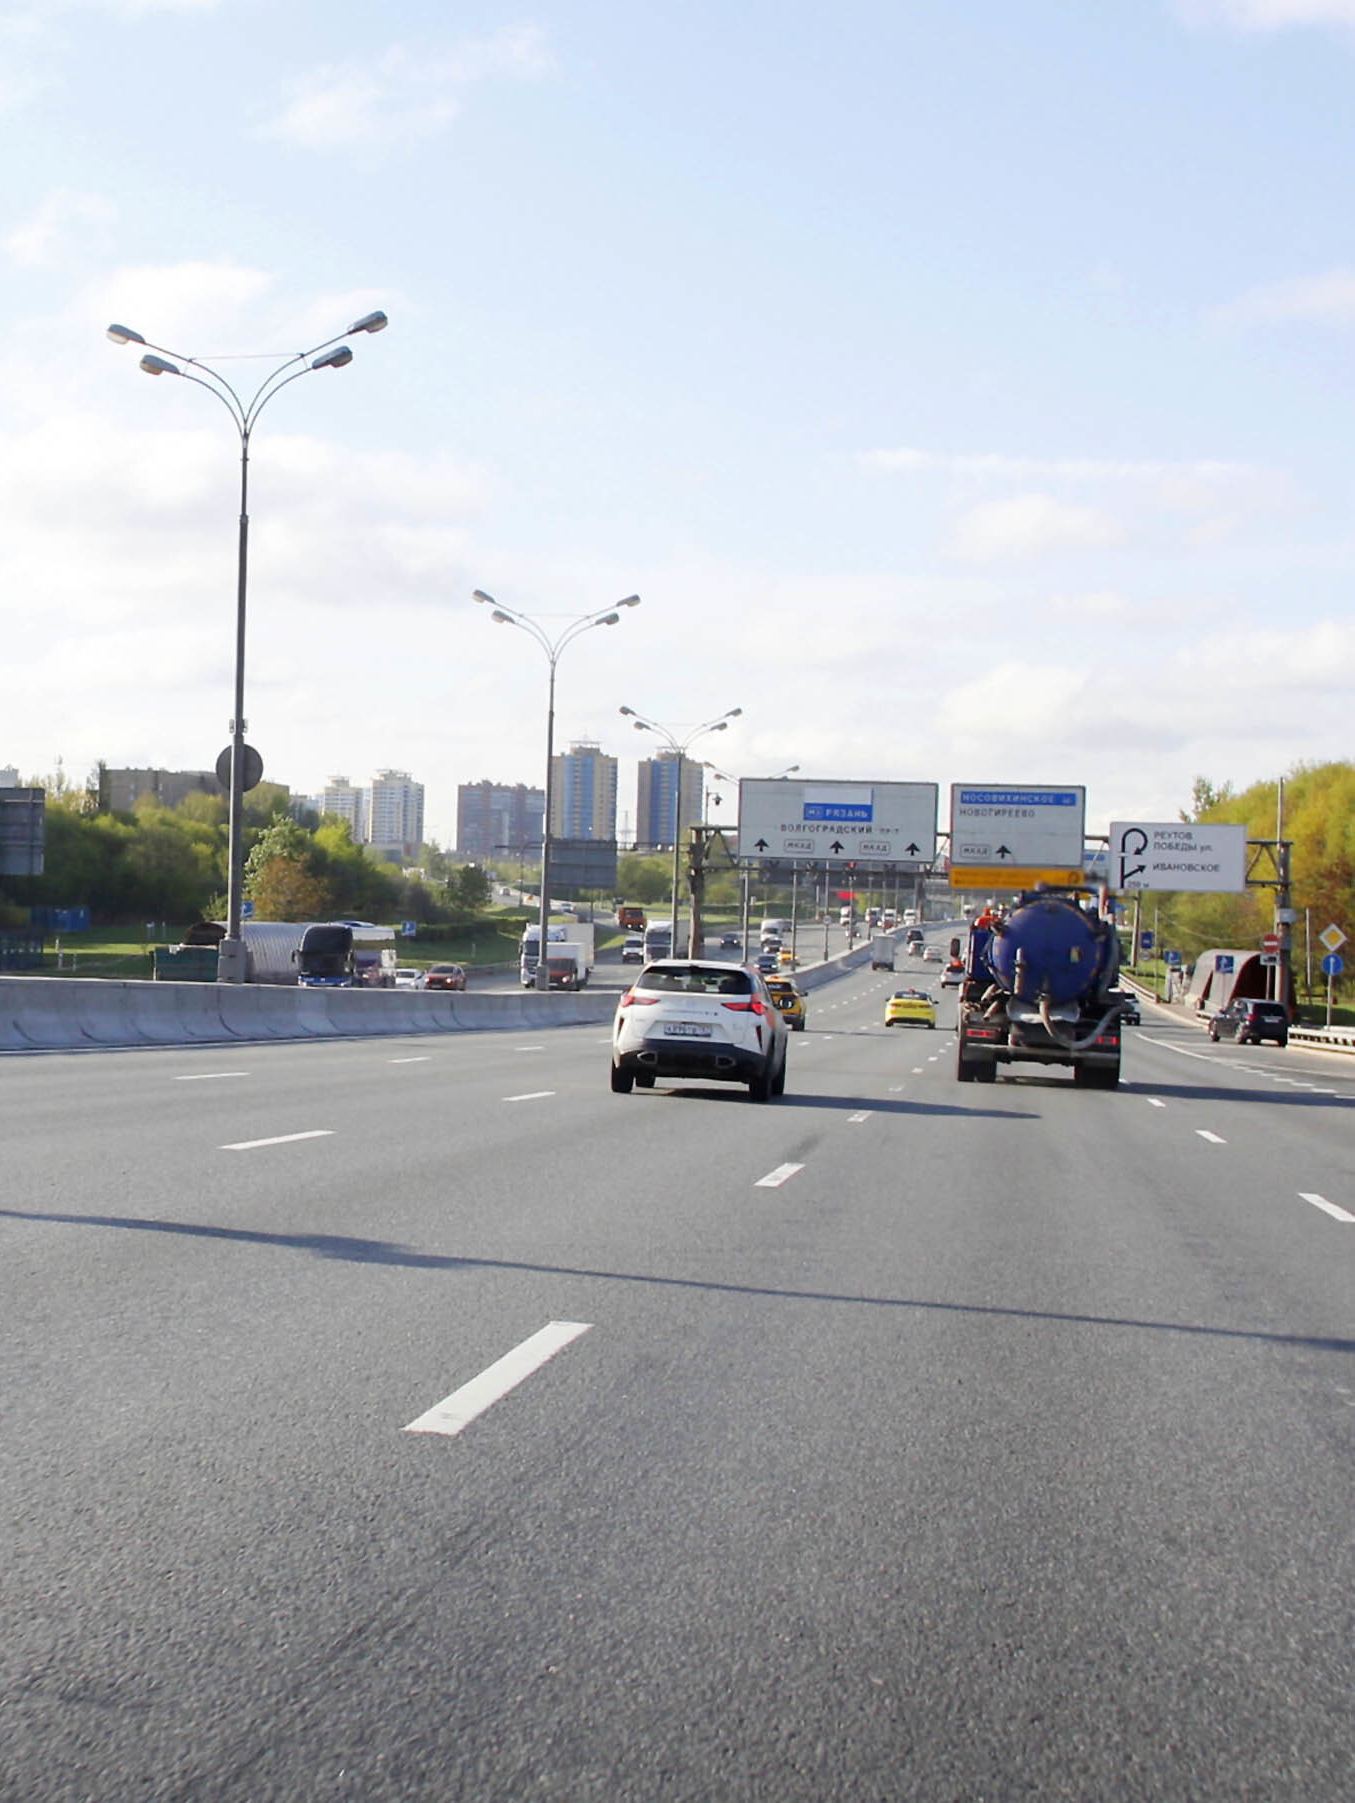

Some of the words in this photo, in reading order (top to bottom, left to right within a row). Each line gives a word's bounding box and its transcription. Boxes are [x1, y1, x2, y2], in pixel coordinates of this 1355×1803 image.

[825, 808, 869, 819] РЯЗАНЬ
[959, 807, 1036, 818] НОВОГИРЕЕВО
[780, 823, 873, 835] ВОЛГОГРАДСКИЙ
[1153, 830, 1193, 840] РЕУТОВ
[1153, 842, 1198, 852] ПОБЕДЫ
[1152, 863, 1220, 873] ИВАНОВСКОЕ
